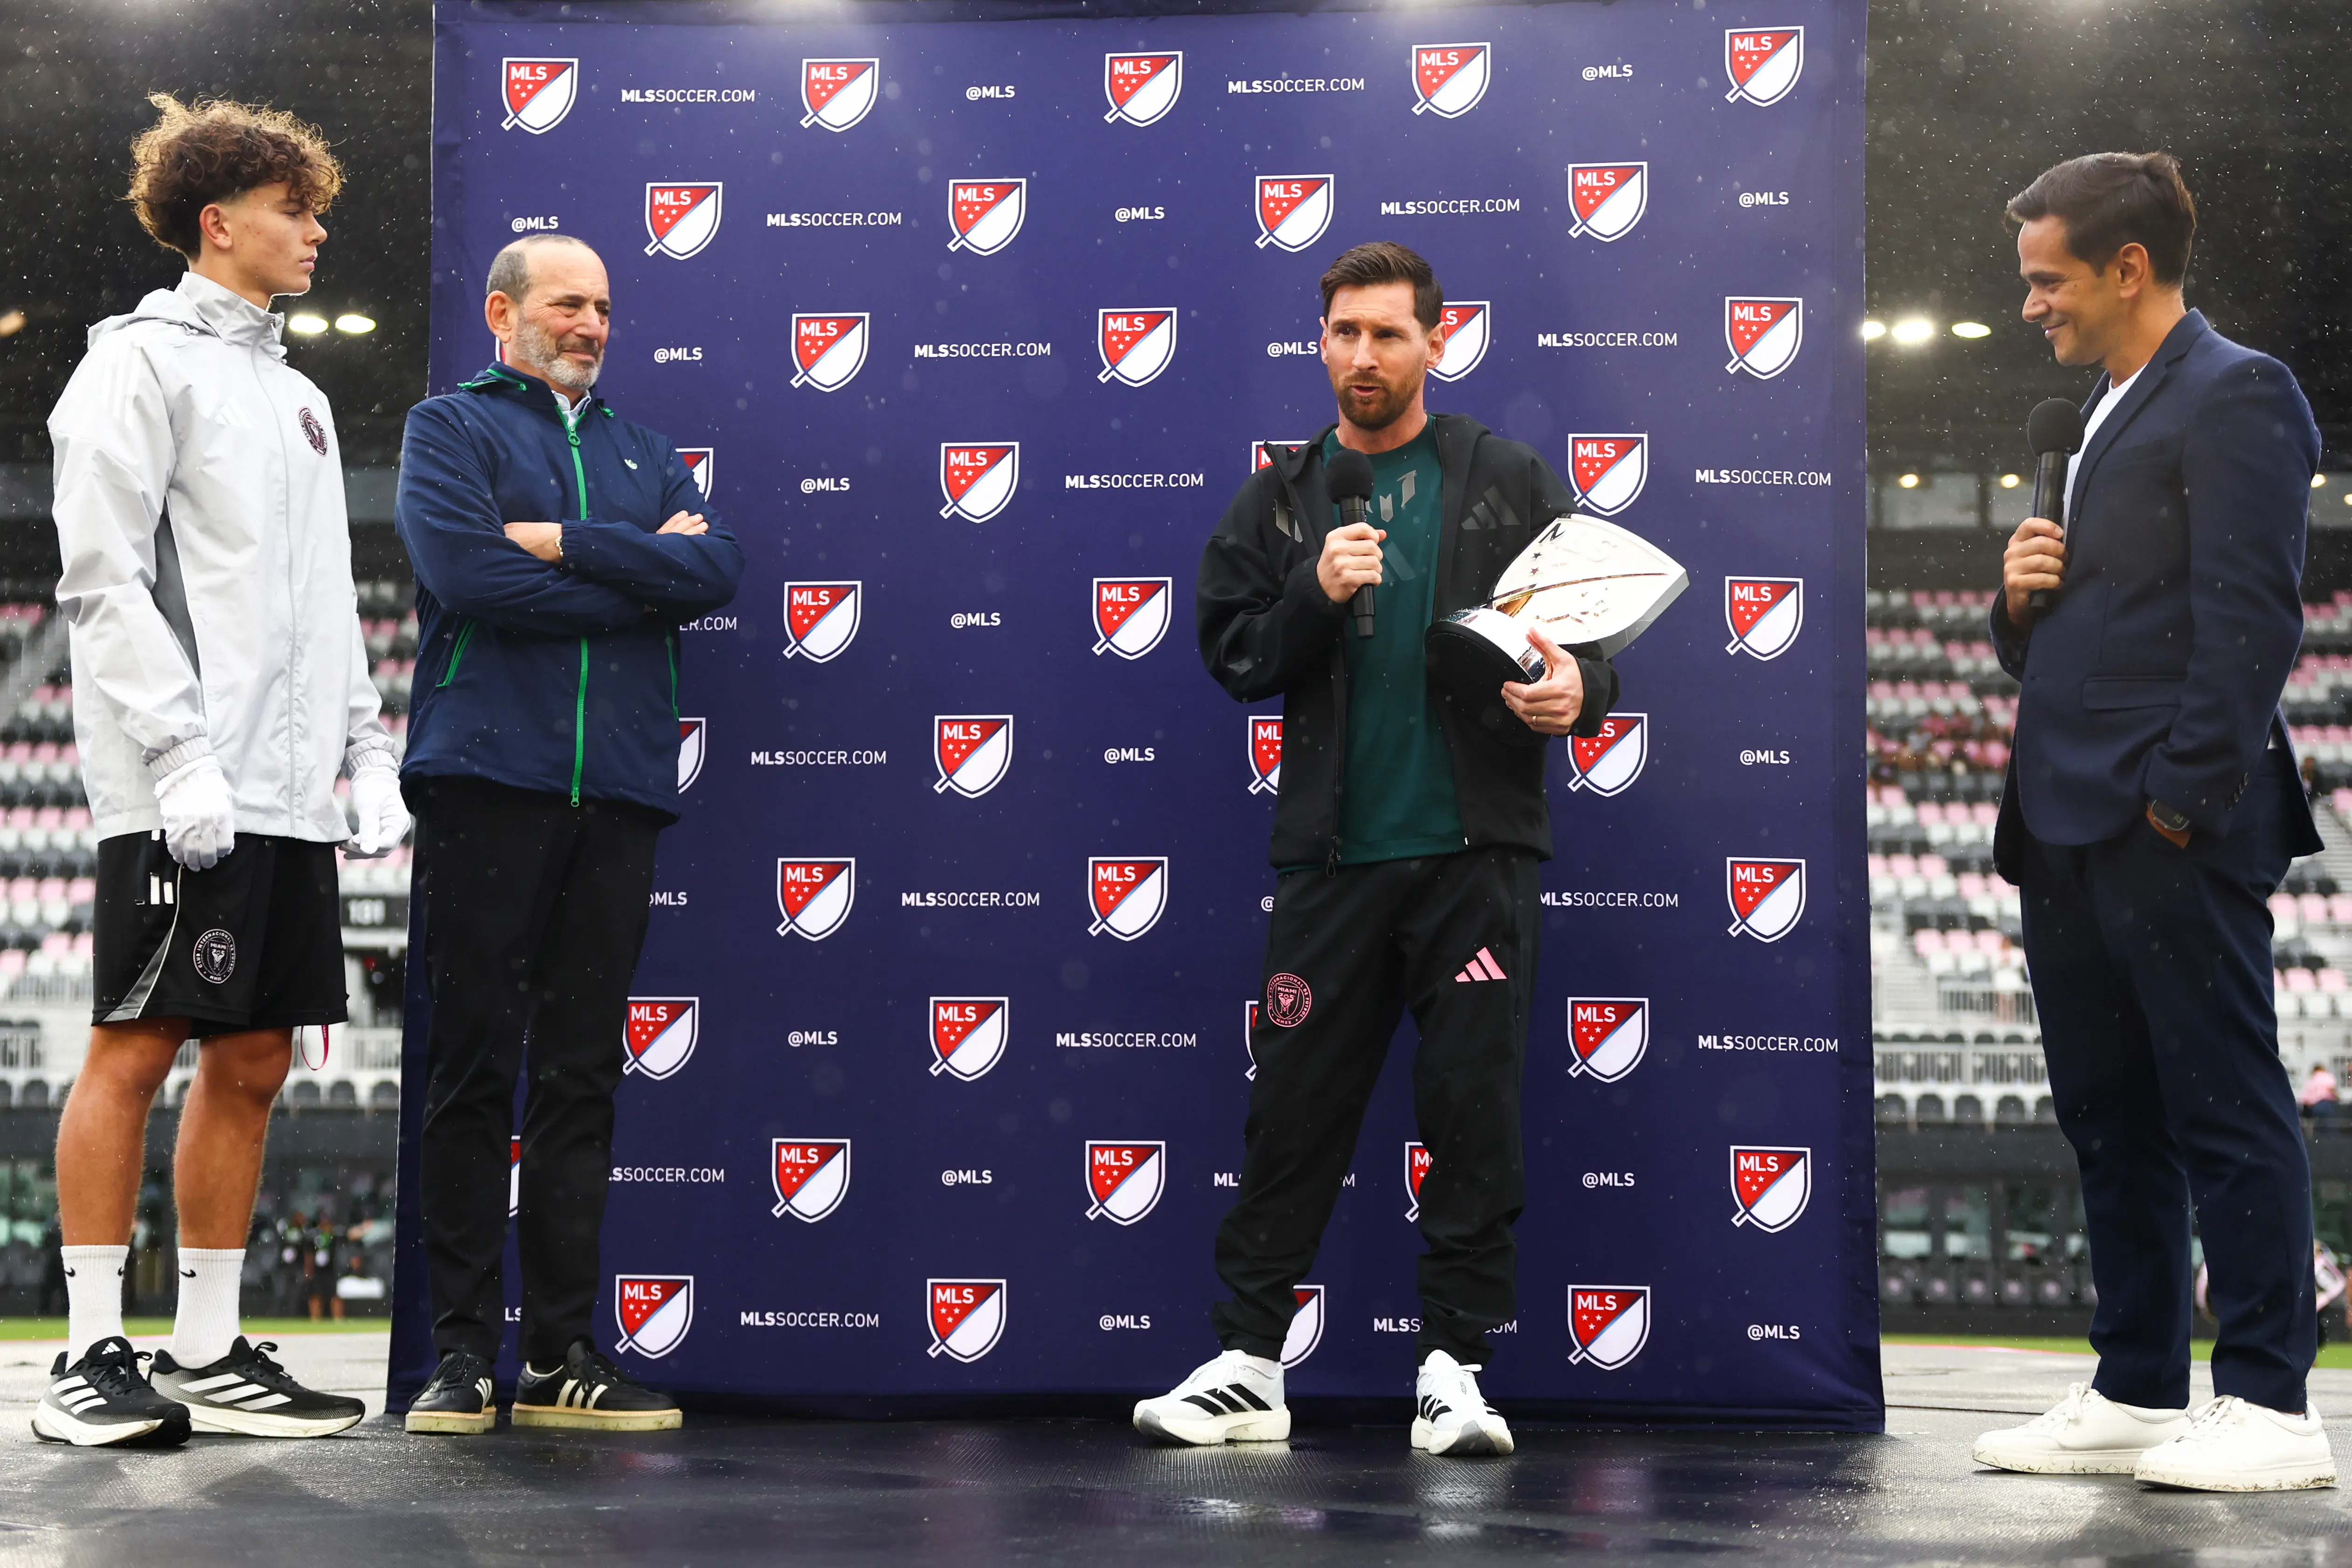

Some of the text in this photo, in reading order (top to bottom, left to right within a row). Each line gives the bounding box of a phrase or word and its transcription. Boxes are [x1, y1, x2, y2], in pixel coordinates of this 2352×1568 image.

[1734, 36, 1772, 52] MLS
[1421, 51, 1459, 67] MLS
[511, 66, 547, 81] MLS
[811, 66, 848, 81] MLS
[1114, 60, 1152, 75] MLS
[1582, 64, 1633, 81] @MLS
[965, 85, 1015, 101] @MLS
[1228, 77, 1364, 93] MLSSOCCER.COM
[621, 89, 755, 103] MLSSOCCER.COM
[1577, 171, 1616, 187] MLS
[654, 191, 691, 206] MLS
[957, 187, 995, 202] MLS
[1264, 183, 1302, 198] MLS
[1381, 198, 1519, 215] MLSSOCCER.COM
[1739, 191, 1789, 208] @MLS
[767, 212, 902, 227] MLSSOCCER.COM
[1115, 207, 1165, 222] @MLS
[511, 216, 559, 233] @MLS
[1734, 305, 1772, 322] MLS
[800, 321, 838, 337] MLS
[1107, 317, 1145, 332] MLS
[1538, 333, 1677, 347] MLSSOCCER.COM
[654, 347, 702, 363] @MLS
[914, 342, 1050, 358] MLSSOCCER.COM
[1267, 341, 1318, 358] @MLS
[950, 451, 987, 466] MLS
[1577, 443, 1616, 458] MLS
[800, 477, 850, 493] @MLS
[1065, 473, 1203, 489] MLSSOCCER.COM
[1695, 469, 1831, 486] MLSSOCCER.COM
[793, 590, 830, 605] MLS
[1102, 586, 1140, 602] MLS
[1734, 585, 1772, 602] MLS
[951, 612, 1001, 629] @MLS
[944, 724, 981, 740] MLS
[1258, 725, 1282, 740] ML
[751, 750, 886, 765] MLSSOCCER.COM
[1104, 748, 1155, 764] @MLS
[1740, 749, 1790, 765] @MLS
[786, 867, 823, 882] MLS
[1097, 866, 1136, 881] MLS
[1736, 867, 1774, 883] MLS
[902, 892, 1040, 906] MLSSOCCER.COM
[631, 1006, 667, 1021] MLS
[939, 1006, 976, 1022] MLS
[1577, 1007, 1616, 1022] MLS
[788, 1031, 838, 1047] @MLS
[1056, 1033, 1196, 1047] MLSSOCCER.COM
[1698, 1035, 1838, 1052] MLSSOCCER.COM
[781, 1148, 819, 1164] MLS
[1095, 1150, 1133, 1166] MLS
[1740, 1155, 1778, 1172] MLS
[609, 1167, 724, 1182] SSOCCER.COM
[942, 1170, 992, 1186] @MLS
[1582, 1173, 1635, 1188] @MLS
[624, 1284, 662, 1300] MLS
[936, 1288, 974, 1304] MLS
[1578, 1295, 1617, 1311] MLS
[741, 1311, 879, 1327] MLSSOCCER.COM
[1099, 1315, 1151, 1331] @MLS
[1748, 1325, 1800, 1340] @MLS
